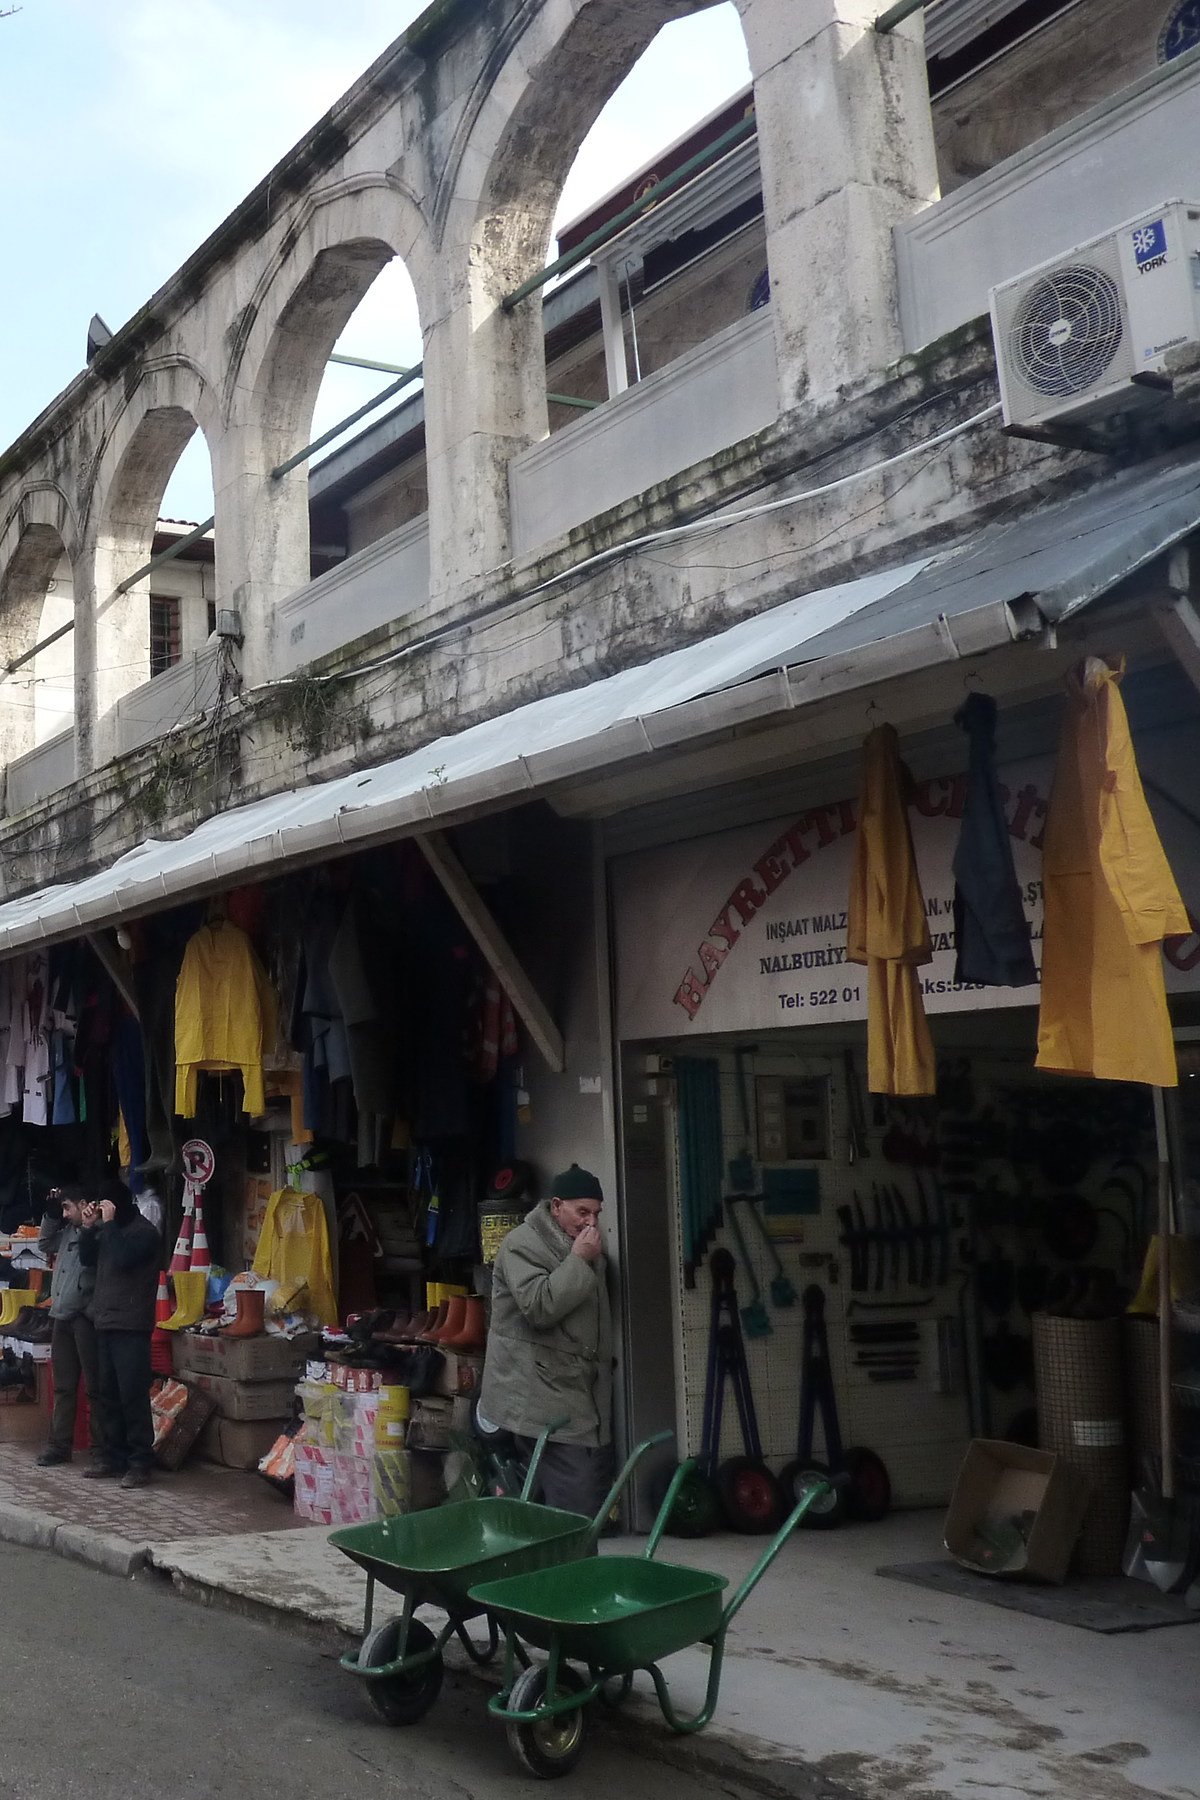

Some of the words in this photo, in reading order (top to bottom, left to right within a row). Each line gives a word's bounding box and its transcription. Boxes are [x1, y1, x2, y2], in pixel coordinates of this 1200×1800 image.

[1137, 254, 1167, 275] YORK
[813, 912, 847, 933] MALZ
[759, 943, 848, 975] NALBURİY
[778, 993, 804, 1009] Tel:
[810, 990, 837, 1006] 522
[842, 987, 861, 1003] 01
